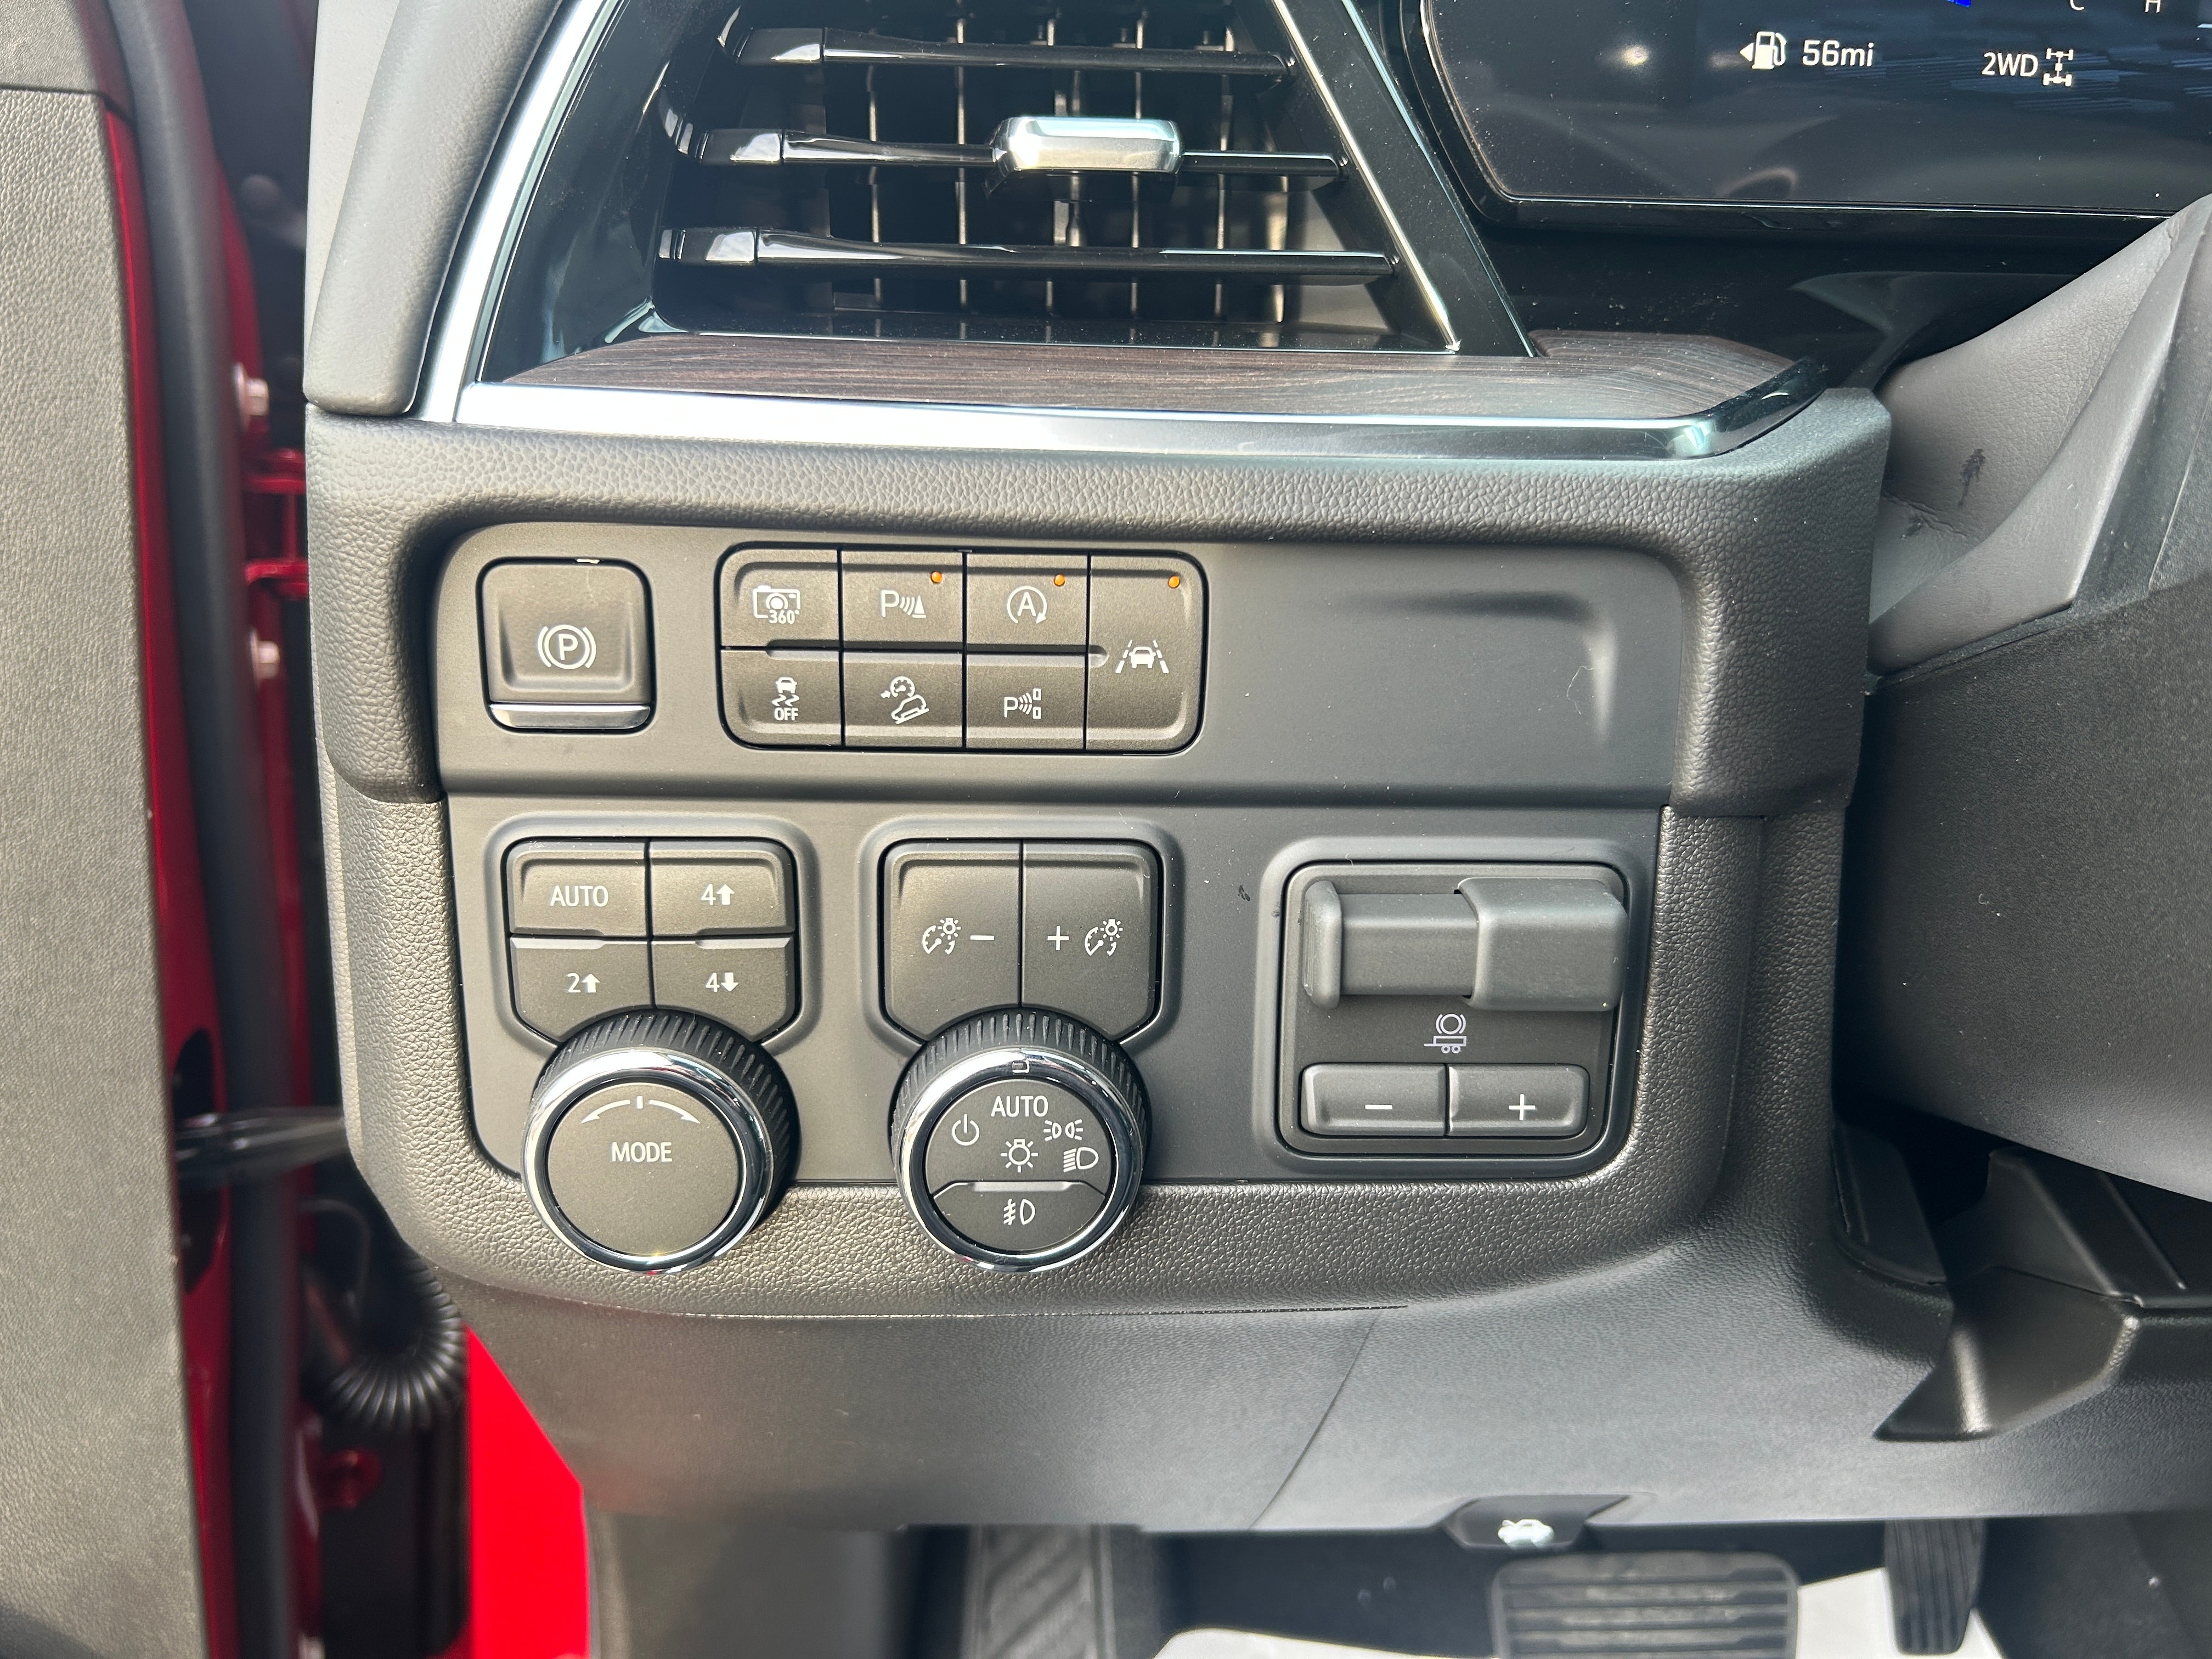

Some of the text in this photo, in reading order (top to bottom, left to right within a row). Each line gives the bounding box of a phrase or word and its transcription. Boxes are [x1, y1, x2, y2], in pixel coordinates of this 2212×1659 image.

[1802, 40, 1874, 67] 56mi
[1982, 52, 2039, 77] 2WD
[881, 590, 899, 618] P
[1016, 592, 1037, 617] A
[768, 610, 795, 624] 360
[557, 634, 578, 661] P
[774, 708, 799, 722] OFF
[550, 885, 609, 907] AUTO
[701, 884, 716, 905] 4
[567, 973, 581, 993] 2
[706, 973, 720, 992] 4
[990, 1095, 1048, 1118] AUTO
[611, 1142, 673, 1163] MODE
